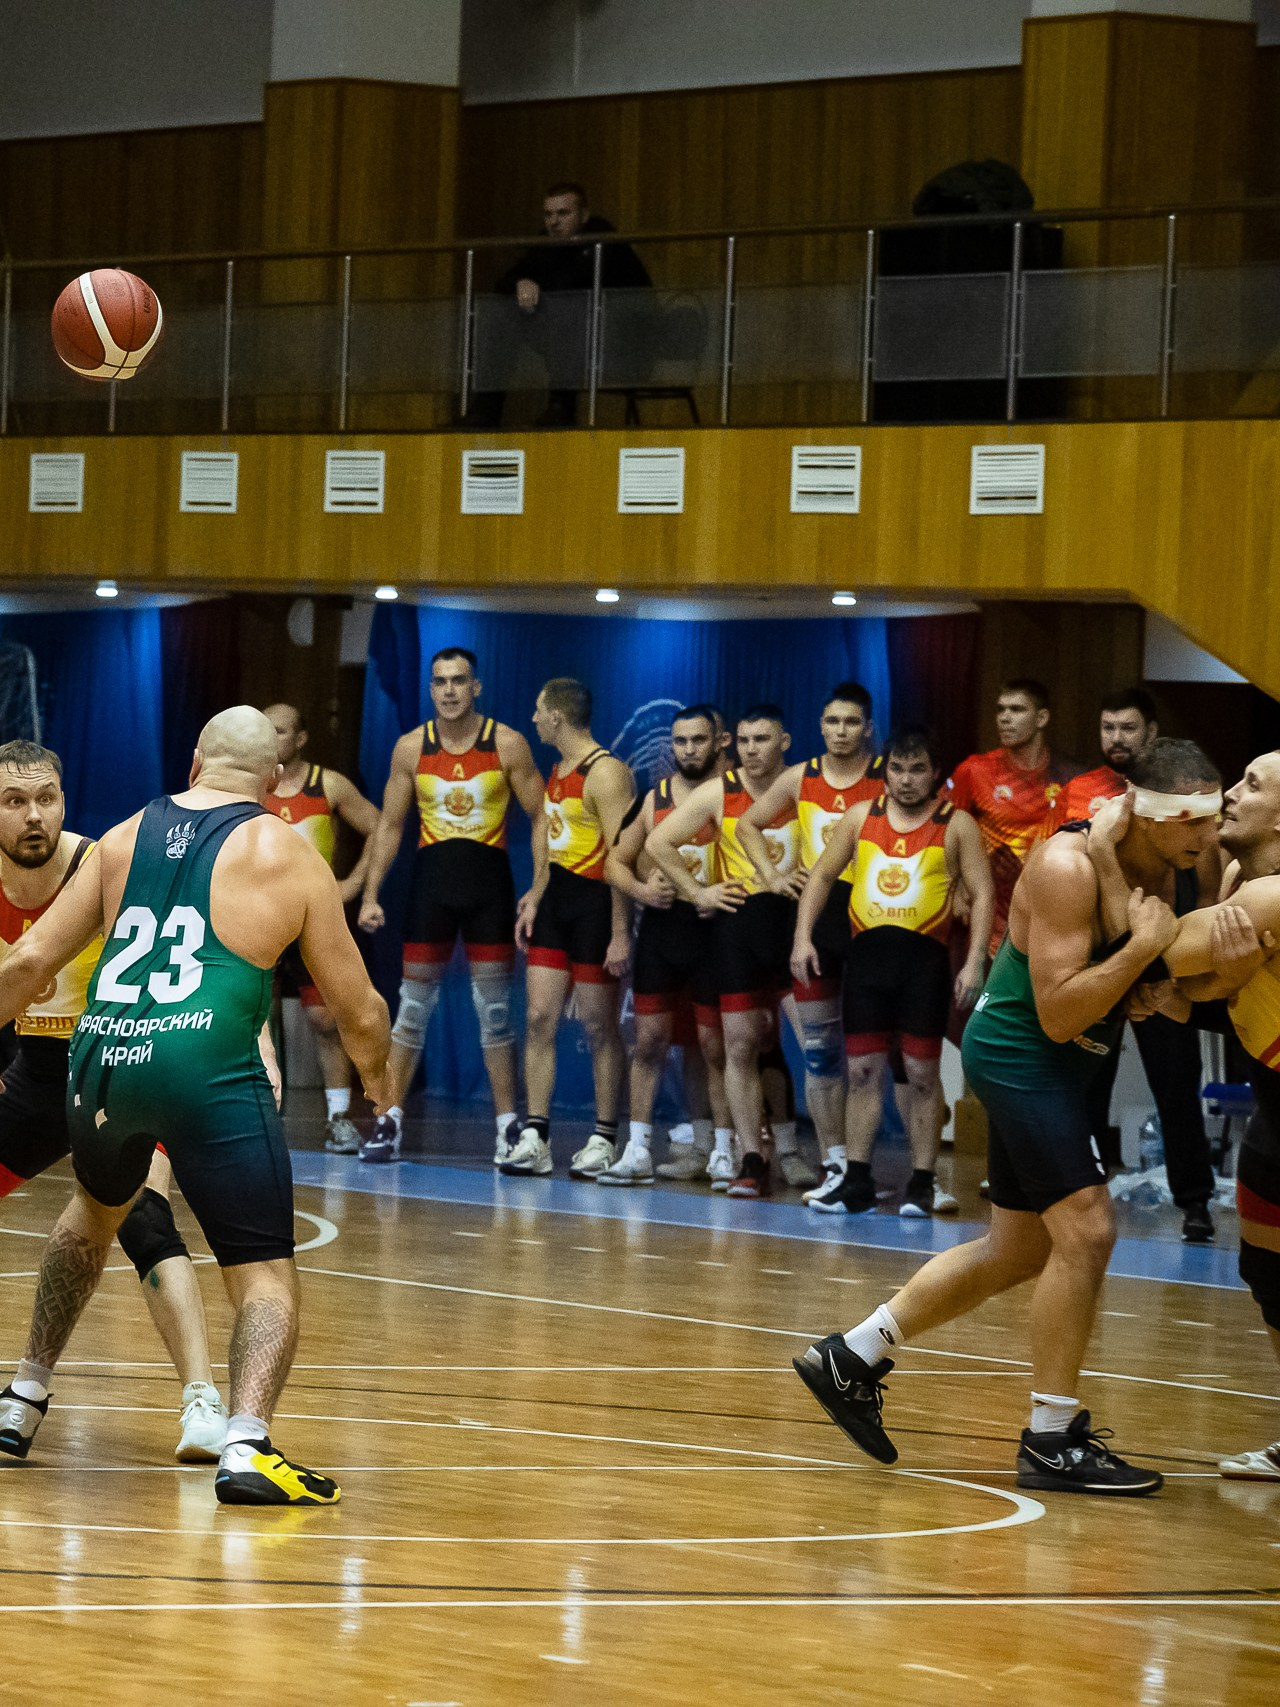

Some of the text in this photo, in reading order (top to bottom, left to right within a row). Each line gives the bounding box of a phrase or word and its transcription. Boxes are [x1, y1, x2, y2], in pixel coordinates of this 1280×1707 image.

[95, 905, 206, 1004] 23
[77, 1008, 214, 1037] КРАСНОЯРСКИЙ
[101, 1040, 154, 1067] КРАЙ
